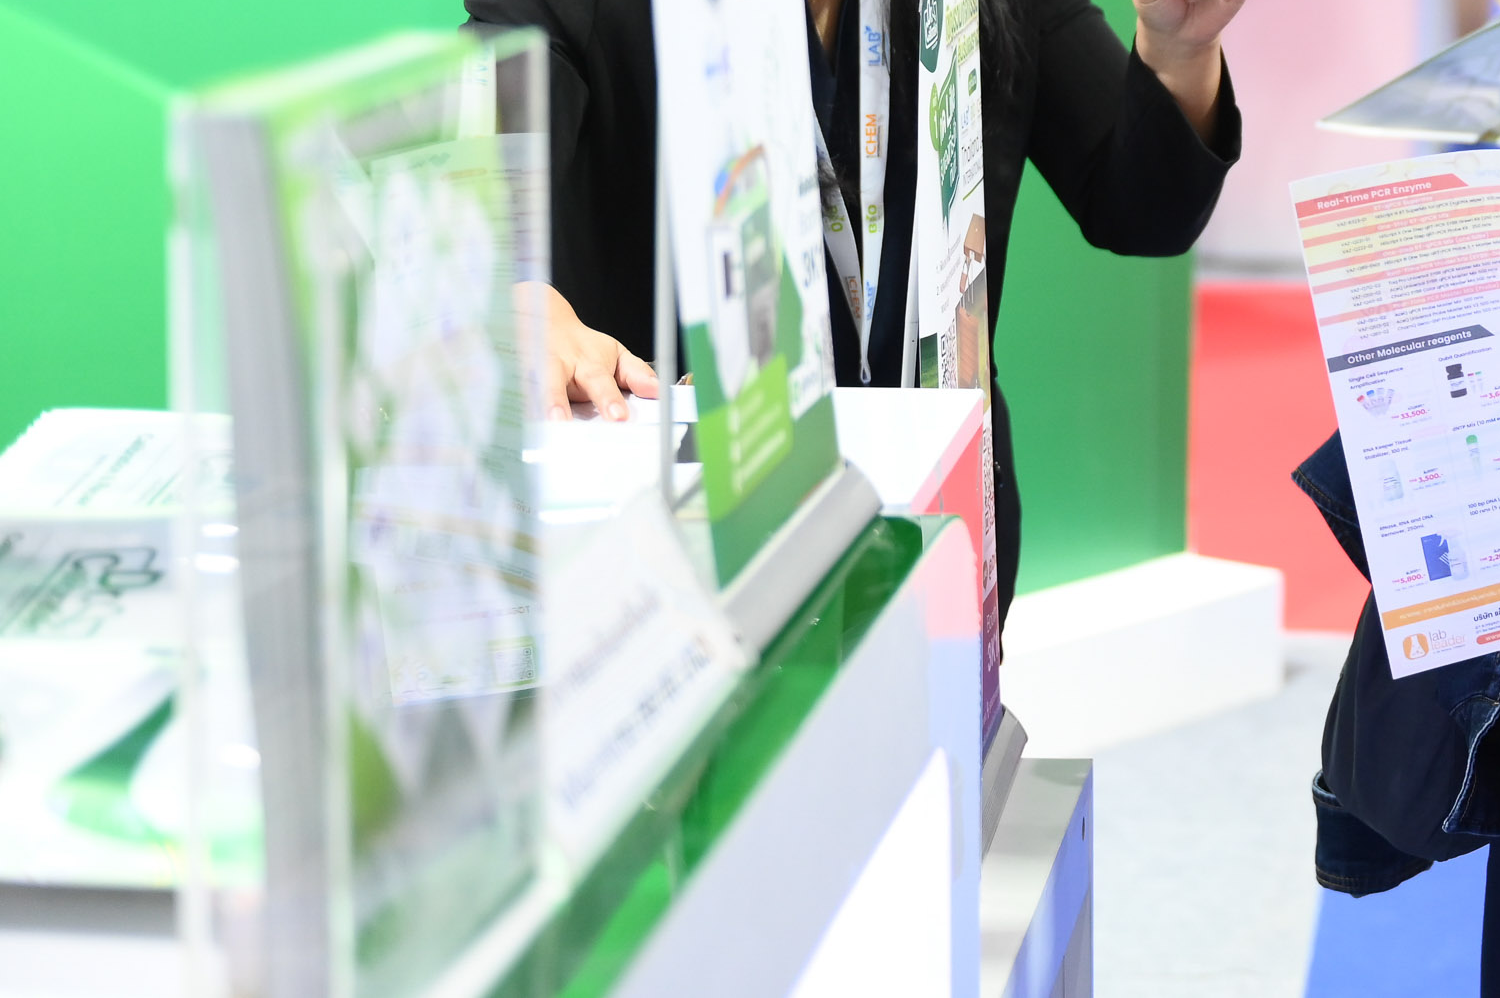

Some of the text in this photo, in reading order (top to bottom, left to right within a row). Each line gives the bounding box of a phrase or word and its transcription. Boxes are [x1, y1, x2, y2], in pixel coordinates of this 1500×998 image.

[865, 113, 878, 156] CHEM
[1317, 193, 1369, 209] Real-Time
[1371, 187, 1391, 198] PCR
[1393, 181, 1432, 194] Enzyme
[866, 204, 878, 234] BIO
[1347, 329, 1472, 364] Other Molecular reagents
[1454, 347, 1492, 358] Quantification
[1377, 367, 1403, 376] Sequence
[1350, 378, 1386, 389] Amplification
[1375, 443, 1394, 451] Keeper
[1473, 612, 1494, 622] บริษัท
[1429, 630, 1447, 644] lab
[1431, 634, 1465, 650] leader
